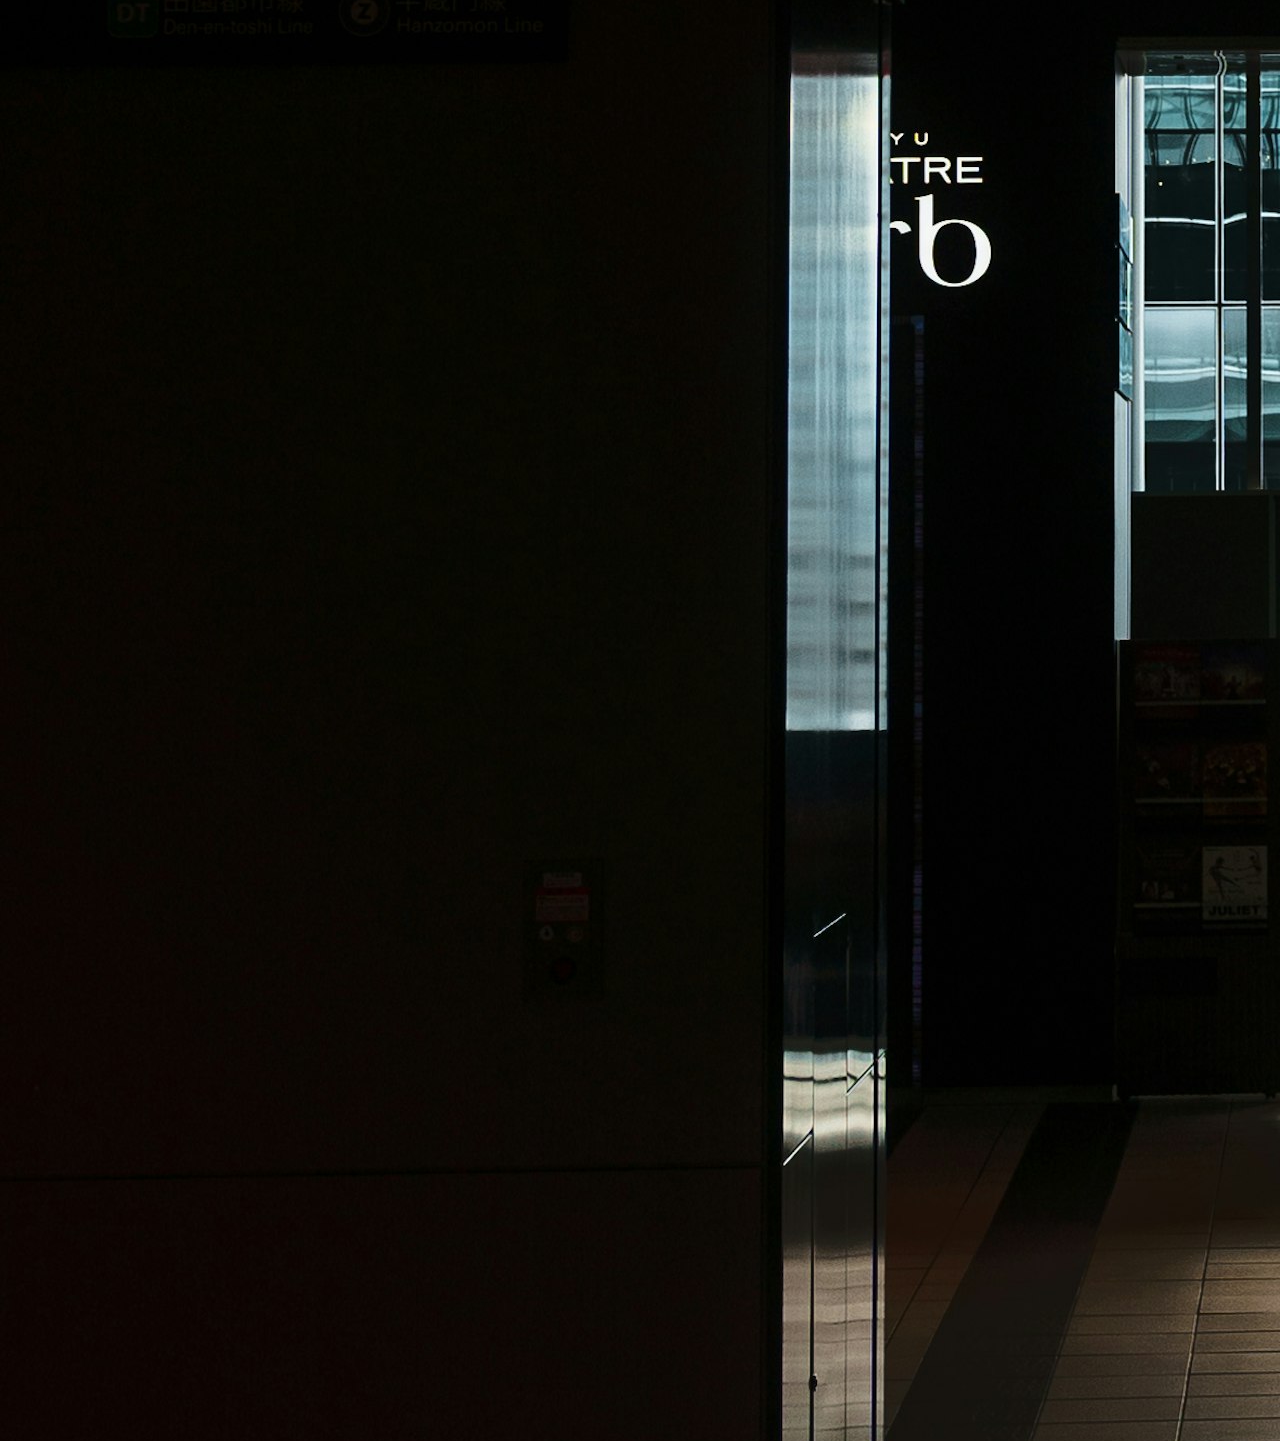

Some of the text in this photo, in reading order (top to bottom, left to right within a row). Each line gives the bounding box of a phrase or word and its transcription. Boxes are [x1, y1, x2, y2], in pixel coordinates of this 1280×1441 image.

[116, 3, 150, 23] DT
[357, 2, 371, 20] Z
[163, 18, 313, 35] Den-en-toshi Line
[396, 17, 545, 33] Hanzomon Line
[890, 156, 984, 184] TRE
[1208, 905, 1260, 916] JULIET
